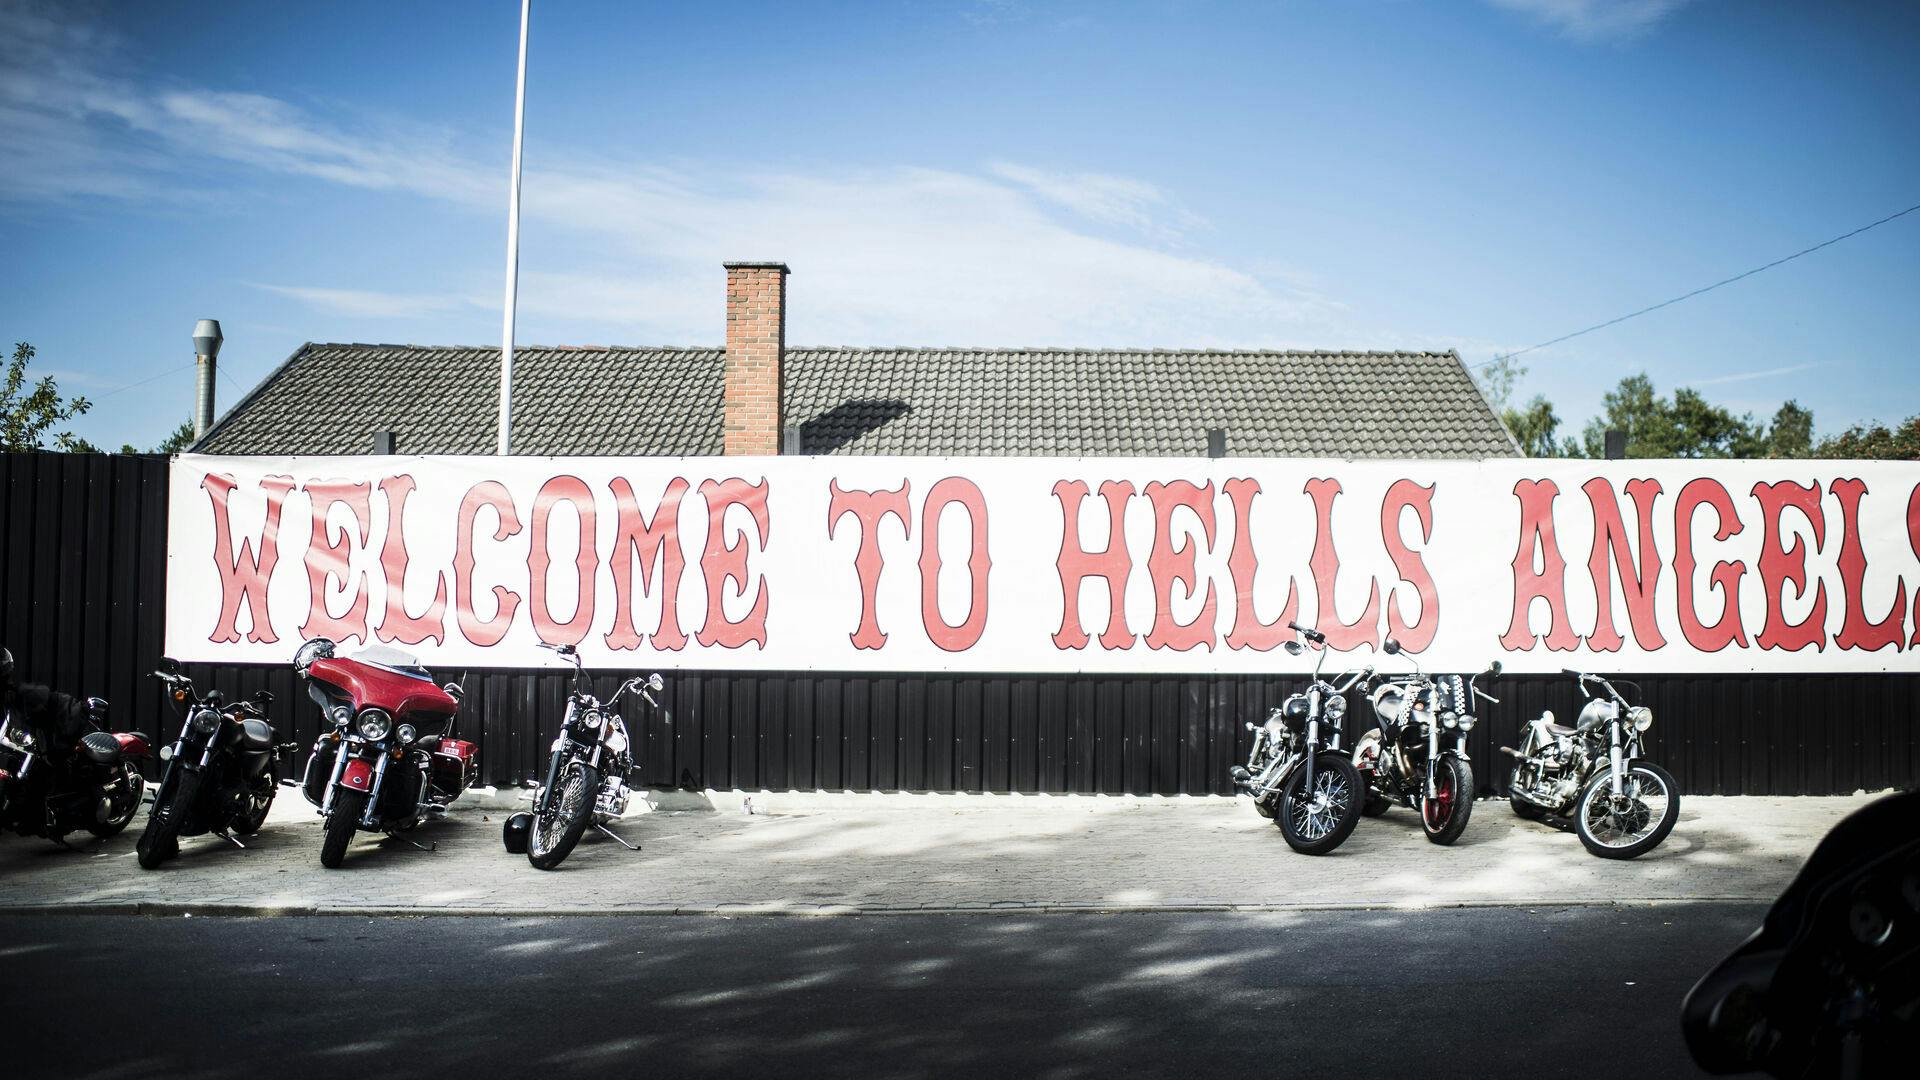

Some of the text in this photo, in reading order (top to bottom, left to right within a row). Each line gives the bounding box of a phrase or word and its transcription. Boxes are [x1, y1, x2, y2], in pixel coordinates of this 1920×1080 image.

[201, 474, 1920, 654] WELCOME TO HELLS ANGEL
